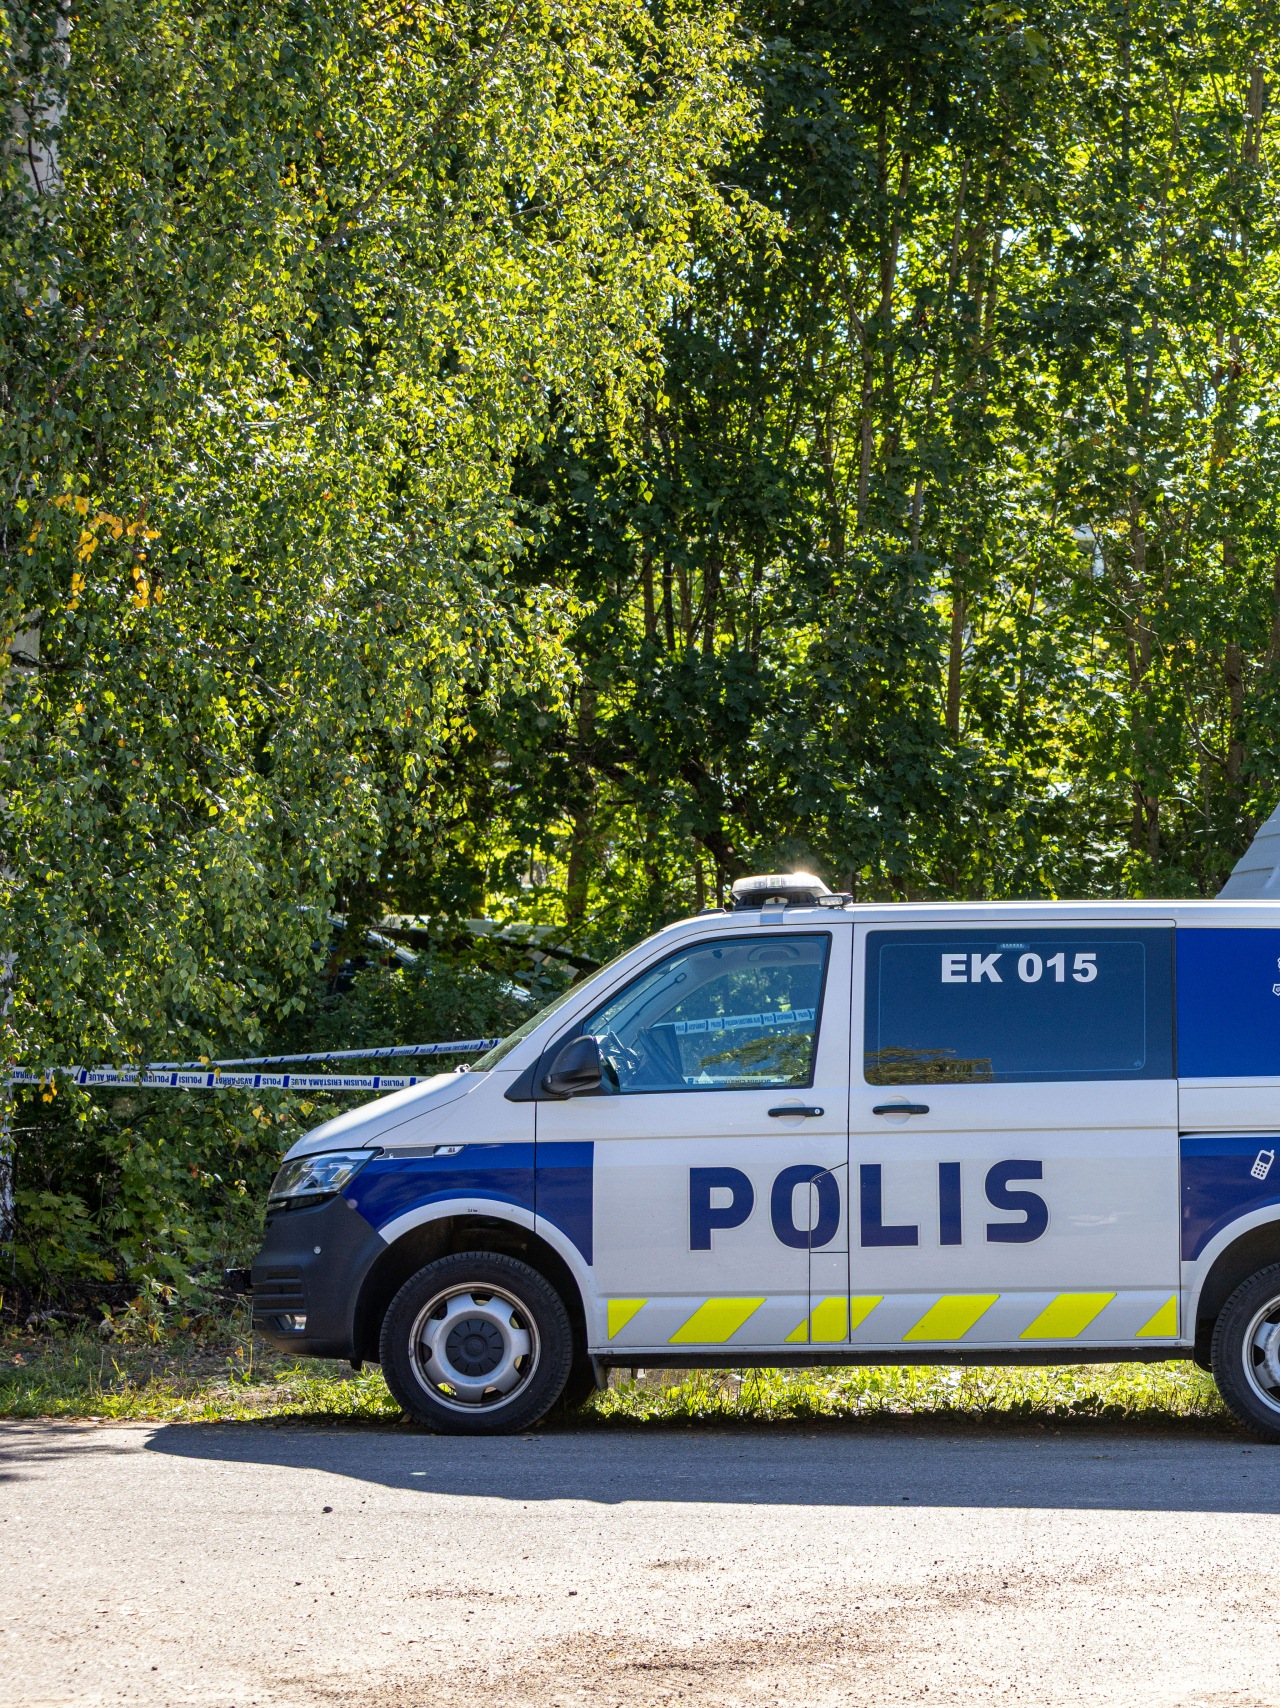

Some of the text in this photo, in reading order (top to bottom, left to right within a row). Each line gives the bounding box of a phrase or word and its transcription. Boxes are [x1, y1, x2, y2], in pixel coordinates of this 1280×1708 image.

[941, 952, 1098, 984] EK 015
[88, 1073, 105, 1082] ALUE
[178, 1076, 202, 1084] POLIISI
[262, 1077, 281, 1085] POLIS
[290, 1078, 307, 1086] ALUE
[308, 1078, 342, 1088] ERISTÄMÄ
[343, 1079, 372, 1087] POLIISIN
[381, 1079, 405, 1087] POLIISI
[689, 1160, 1050, 1251] POLIS
